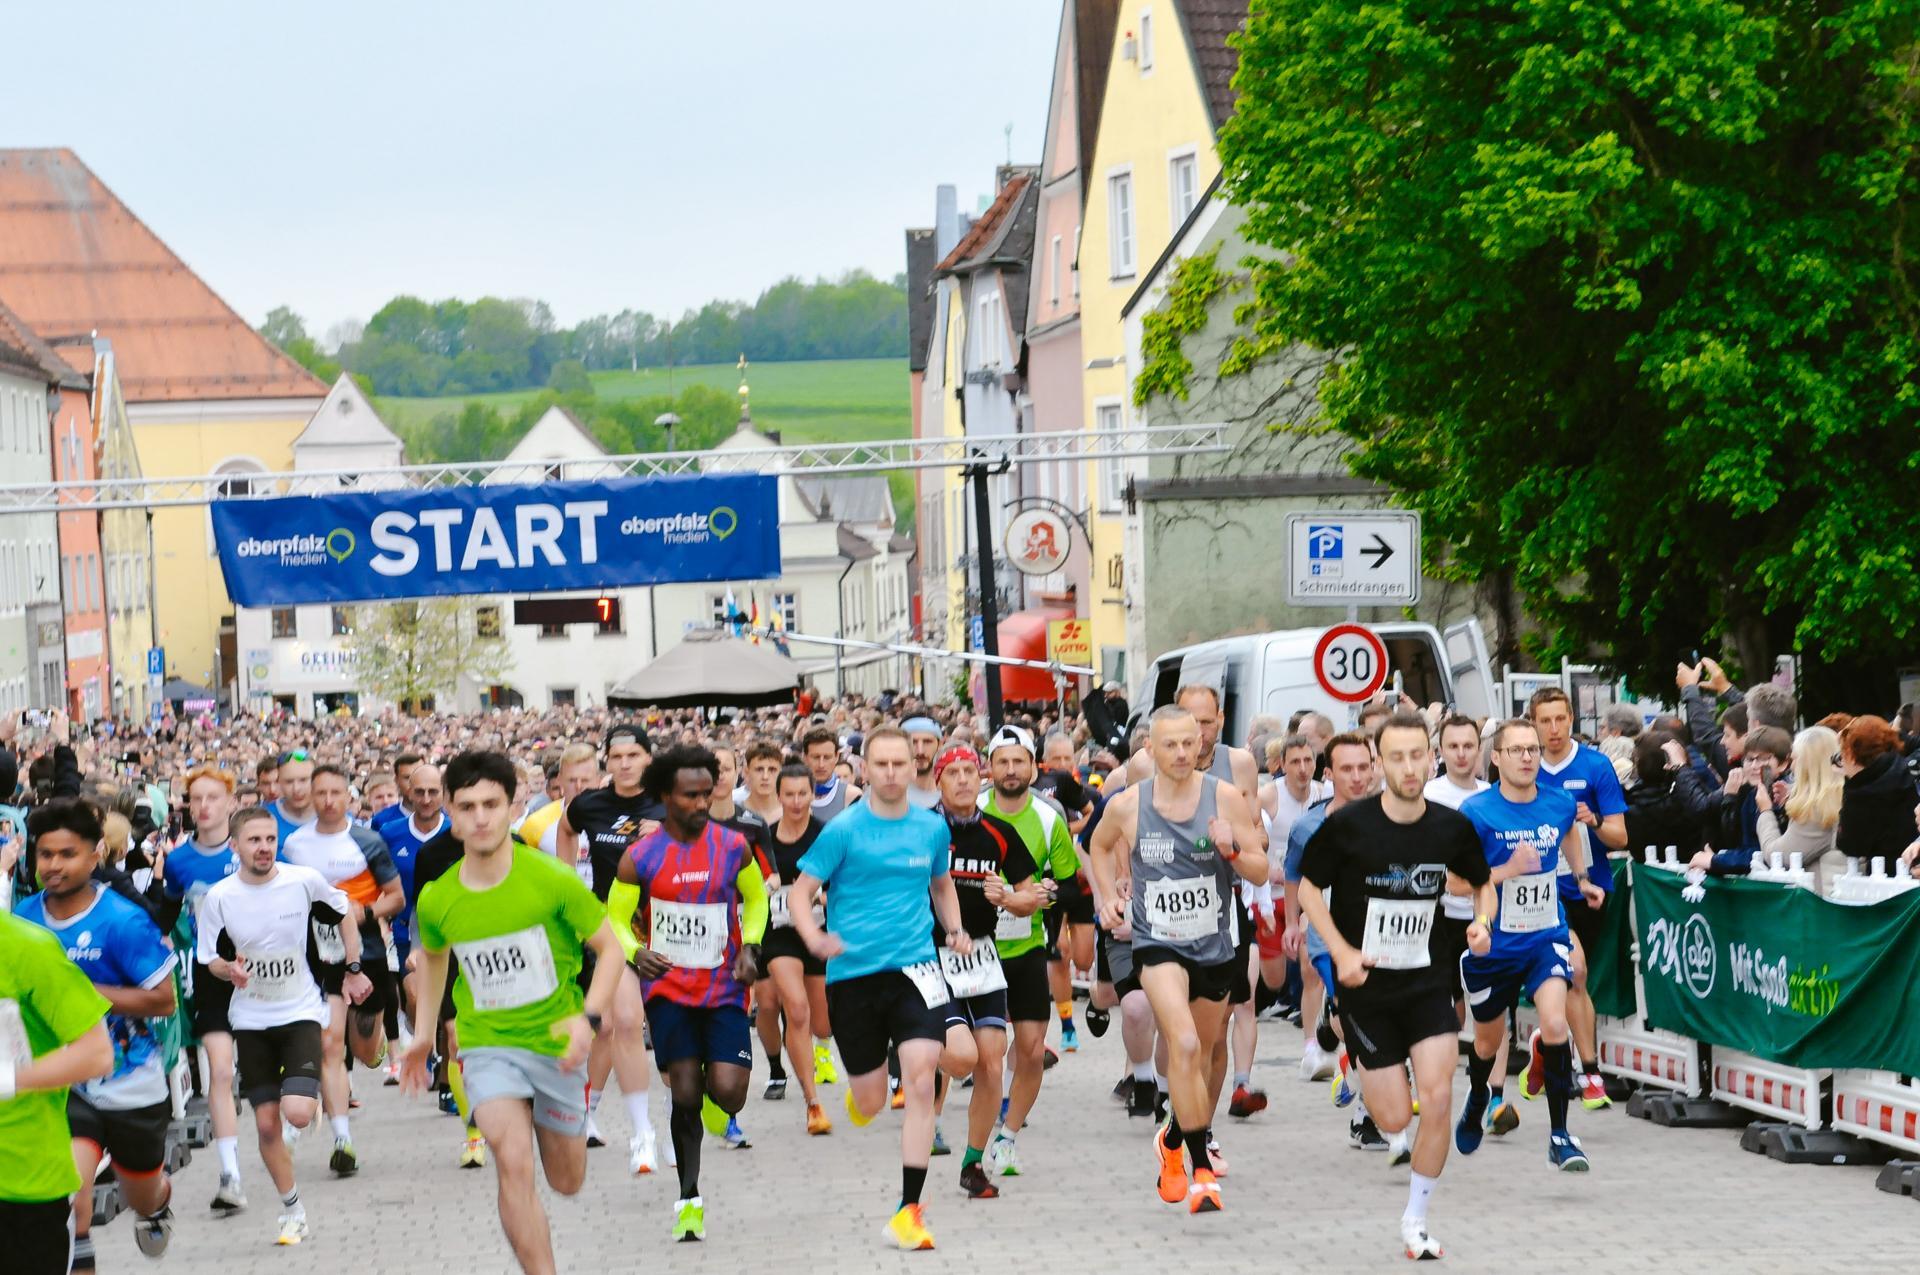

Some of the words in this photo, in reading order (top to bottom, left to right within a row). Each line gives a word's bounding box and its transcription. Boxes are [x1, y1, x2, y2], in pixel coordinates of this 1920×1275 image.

[621, 512, 708, 538] oberpfalz
[237, 533, 326, 559] oberpfalz
[369, 500, 609, 577] START
[664, 530, 710, 545] medien
[1319, 535, 1336, 558] P
[281, 554, 327, 567] medien
[1300, 581, 1405, 596] Schmiedrangen
[598, 599, 609, 621] 7
[1055, 643, 1089, 654] LOTTO
[1330, 647, 1370, 681] 30
[595, 833, 627, 844] ZIEGLER
[1505, 830, 1535, 841] BAYERN
[681, 871, 710, 882] TERREX
[1155, 888, 1210, 913] 4893
[1516, 883, 1551, 906] 814
[656, 912, 707, 937] 2535
[1169, 913, 1199, 923] Andreas
[1375, 912, 1428, 936] 1906
[244, 957, 295, 979] 2808
[464, 945, 526, 979] 1968
